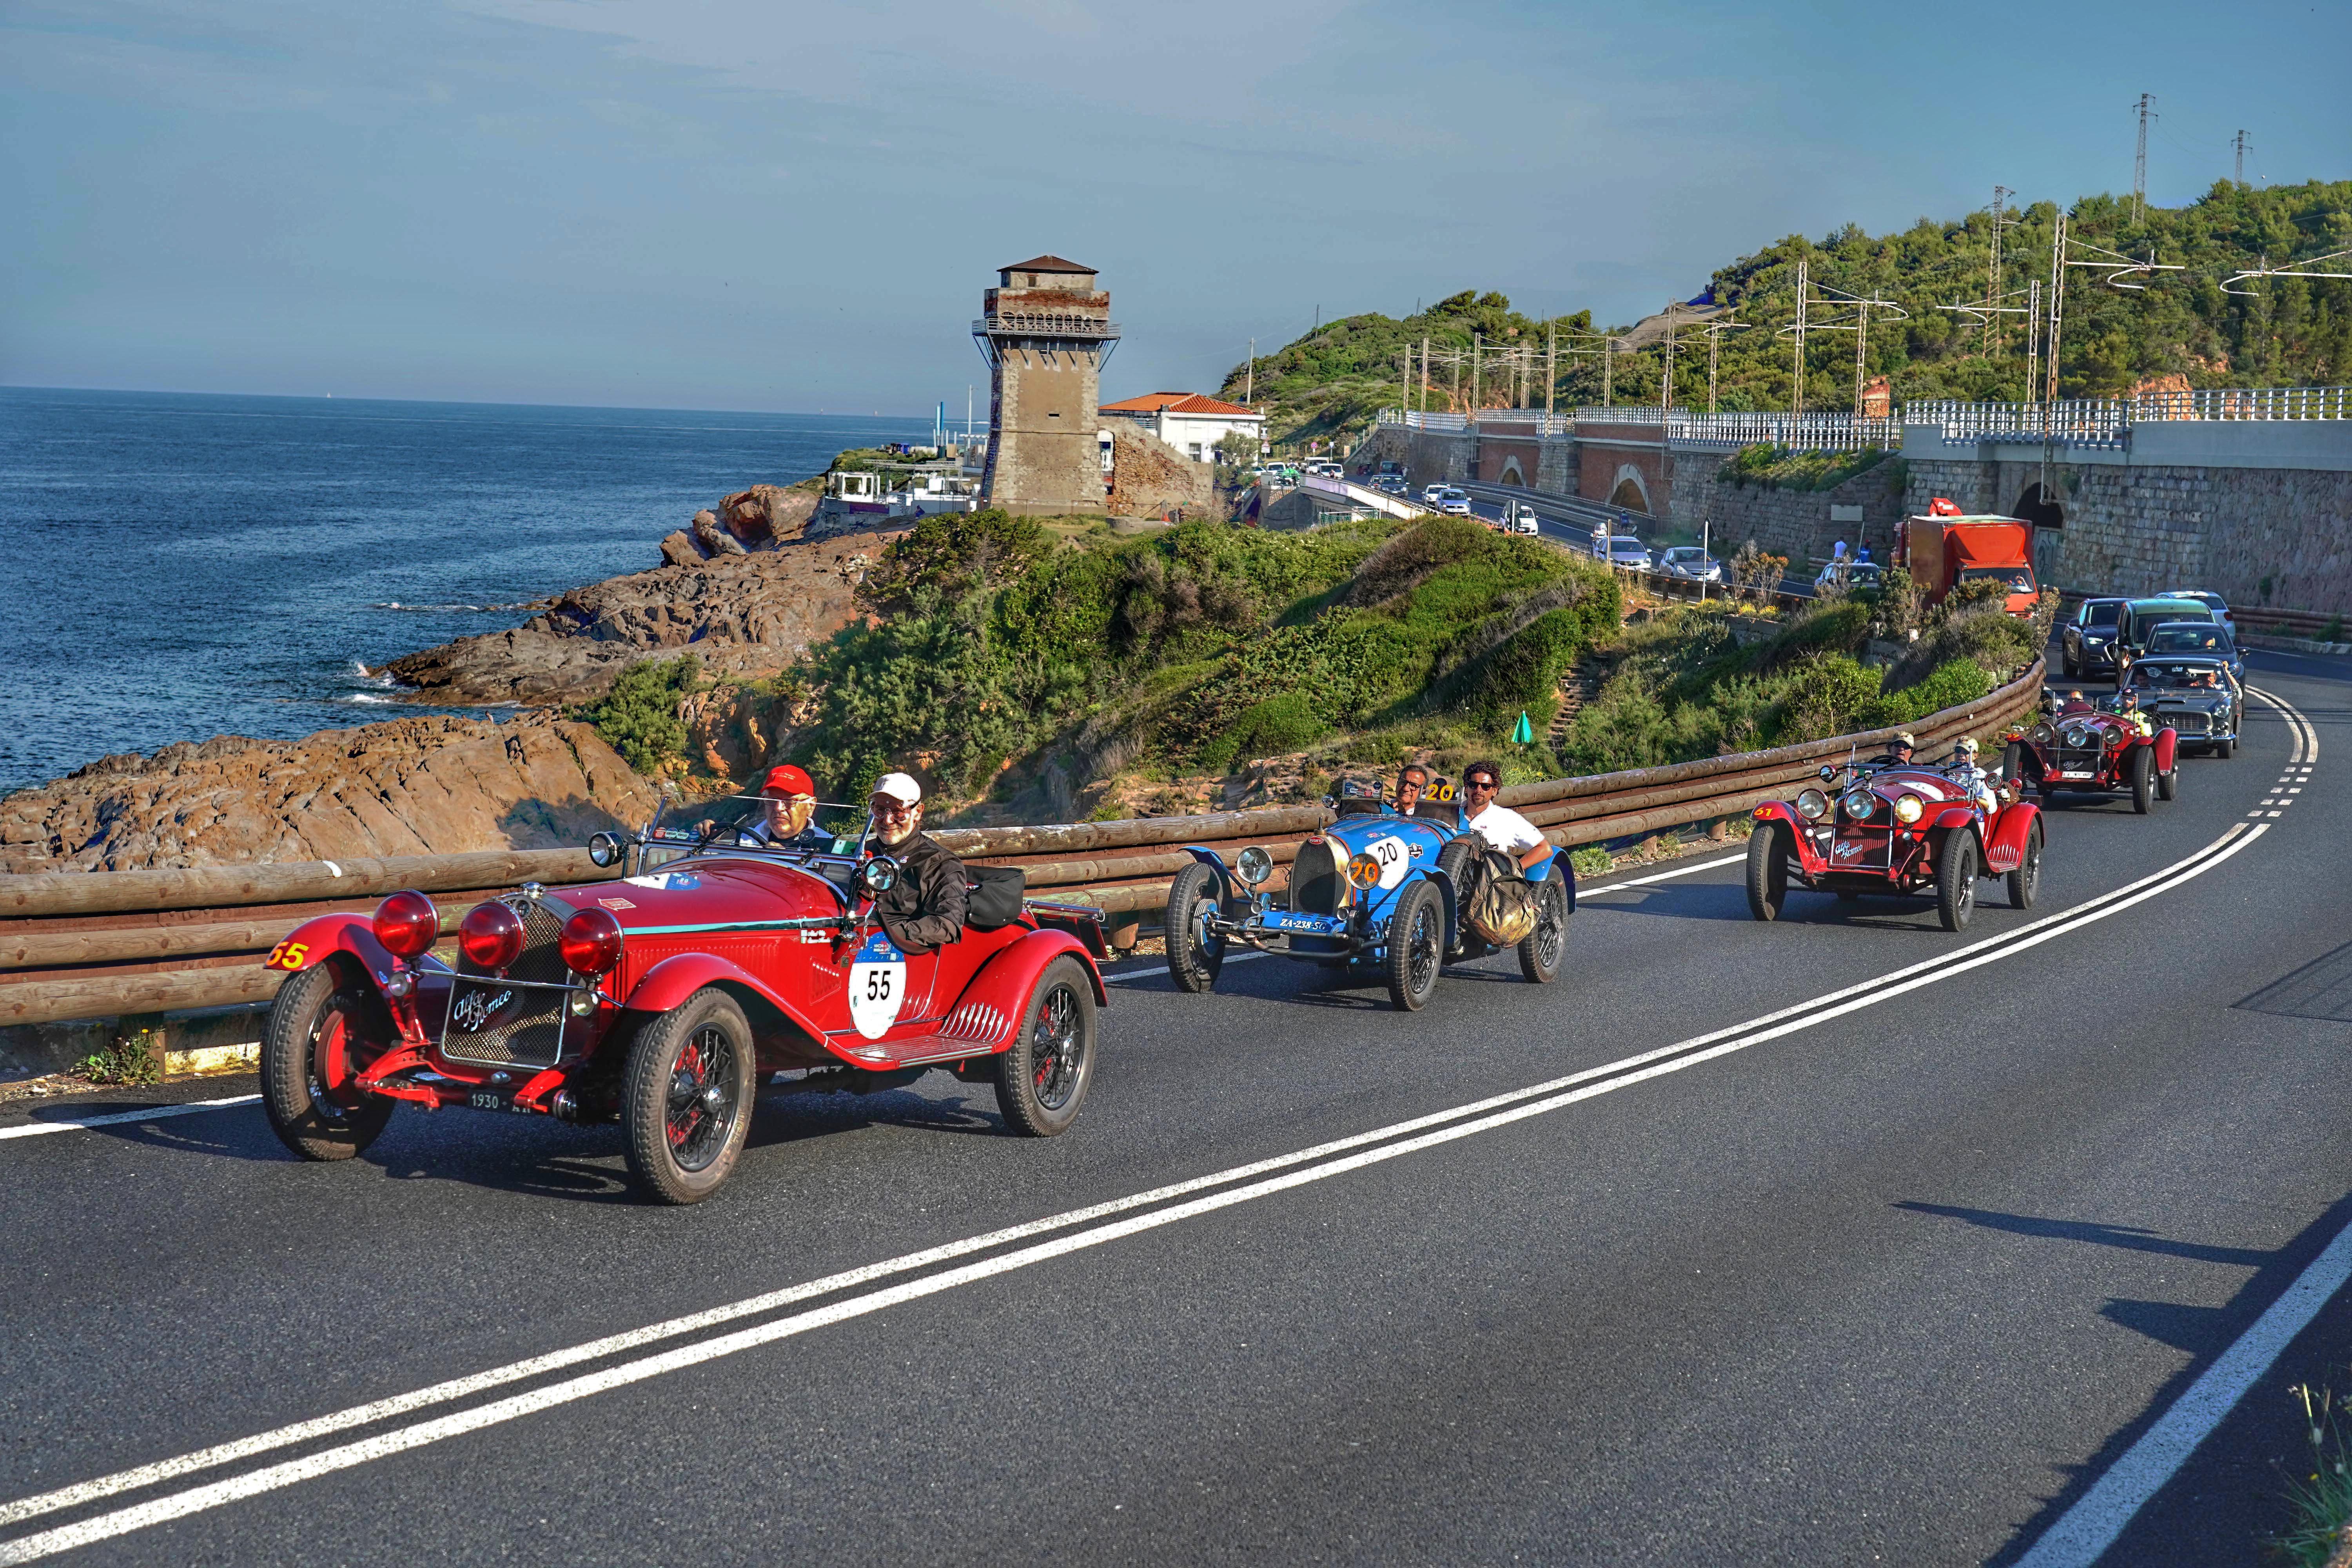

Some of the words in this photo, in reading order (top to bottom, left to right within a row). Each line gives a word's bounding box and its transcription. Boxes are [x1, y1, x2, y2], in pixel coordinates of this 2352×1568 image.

[1425, 784, 1454, 802] 20
[1754, 807, 1772, 817] 61
[1378, 843, 1397, 866] 20
[1835, 841, 1850, 858] Alfa
[1844, 844, 1863, 860] Romeo
[1351, 862, 1378, 882] 20
[1280, 919, 1327, 930] ZA-238-SG
[266, 942, 310, 968] 55
[867, 971, 891, 1000] 55
[454, 990, 485, 1027] Alfa
[470, 991, 512, 1031] Romeo
[472, 1094, 499, 1109] 1930
